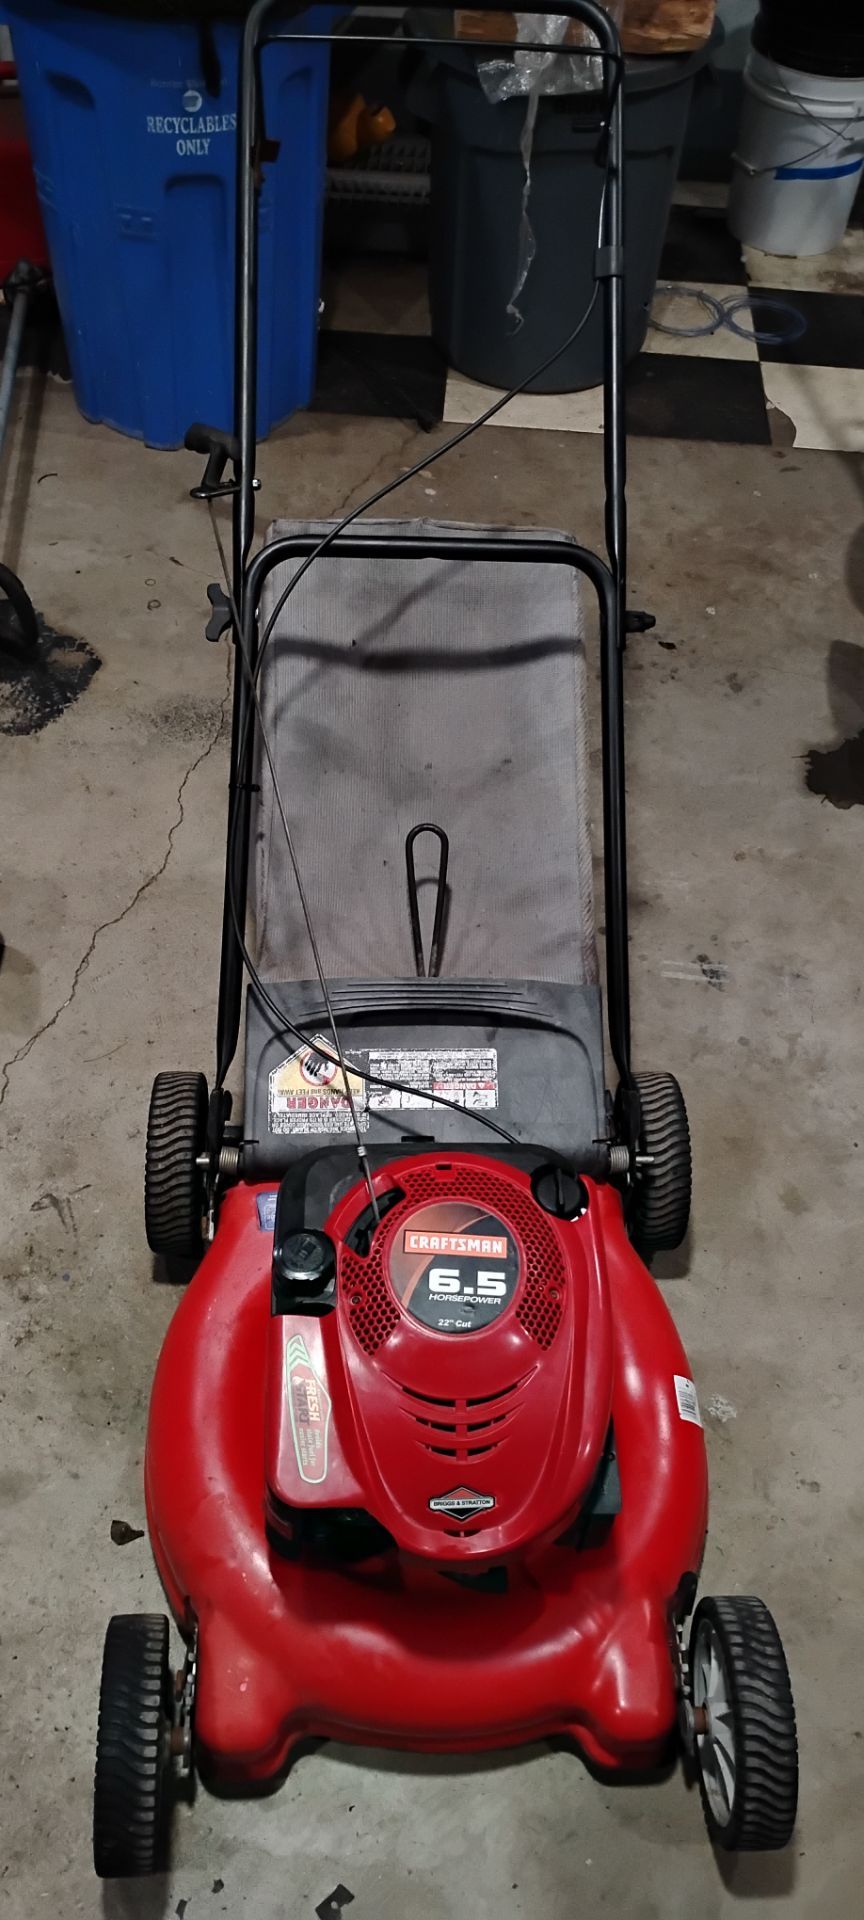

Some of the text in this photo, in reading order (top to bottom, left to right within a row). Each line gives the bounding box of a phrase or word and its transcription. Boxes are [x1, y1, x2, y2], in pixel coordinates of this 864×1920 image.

[147, 113, 237, 134] RECYCLABLES
[176, 139, 211, 156] ONLY
[286, 1096, 351, 1110] DANGER
[409, 1235, 503, 1254] CRAFTSMAN
[428, 1268, 507, 1297] 6.5
[429, 1293, 502, 1305] HORSEPOWER
[437, 1318, 472, 1328] 22" Cut
[296, 1384, 311, 1426] START
[305, 1379, 321, 1422] FRESH
